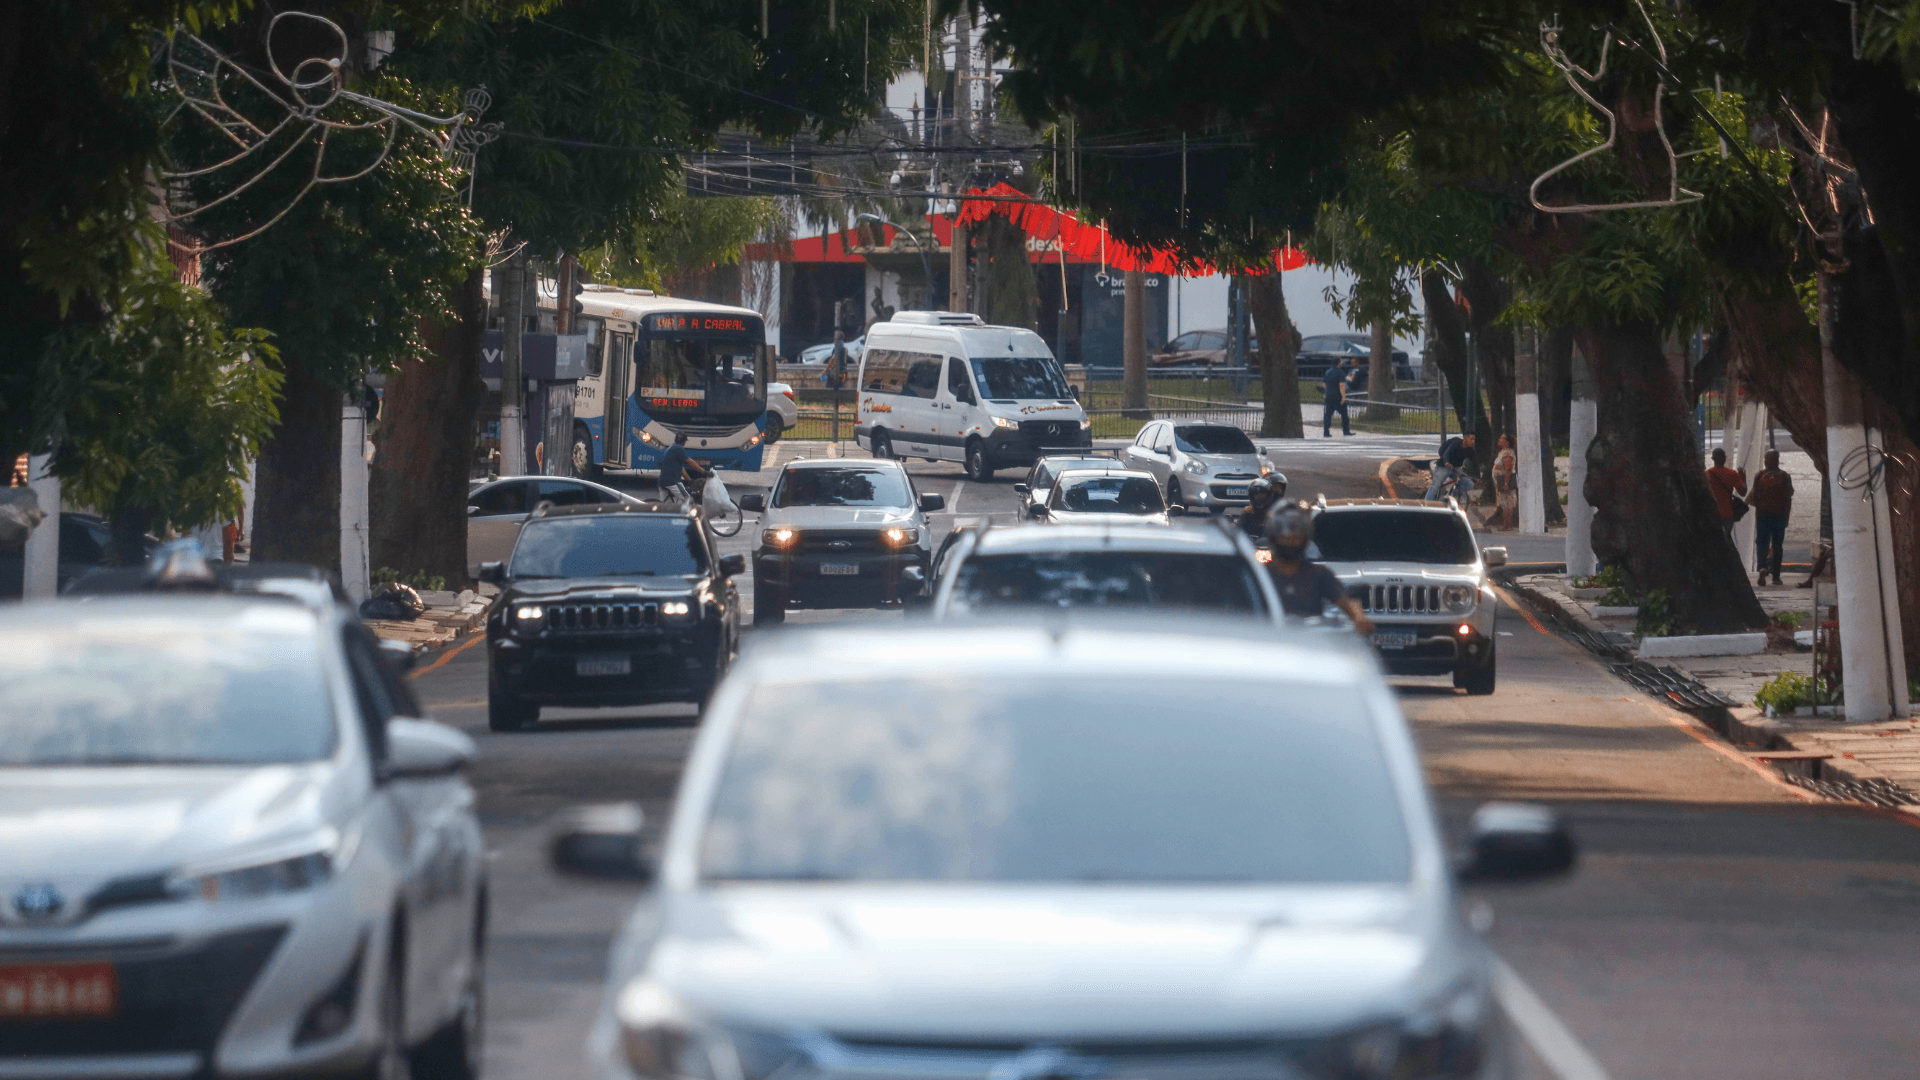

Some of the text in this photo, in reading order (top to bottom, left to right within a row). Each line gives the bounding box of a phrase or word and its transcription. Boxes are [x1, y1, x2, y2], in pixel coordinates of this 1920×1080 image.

[1111, 276, 1159, 287] brco
[678, 318, 686, 329] P
[691, 319, 699, 329] A
[705, 319, 746, 331] CABRAL
[637, 454, 656, 463] 4901
